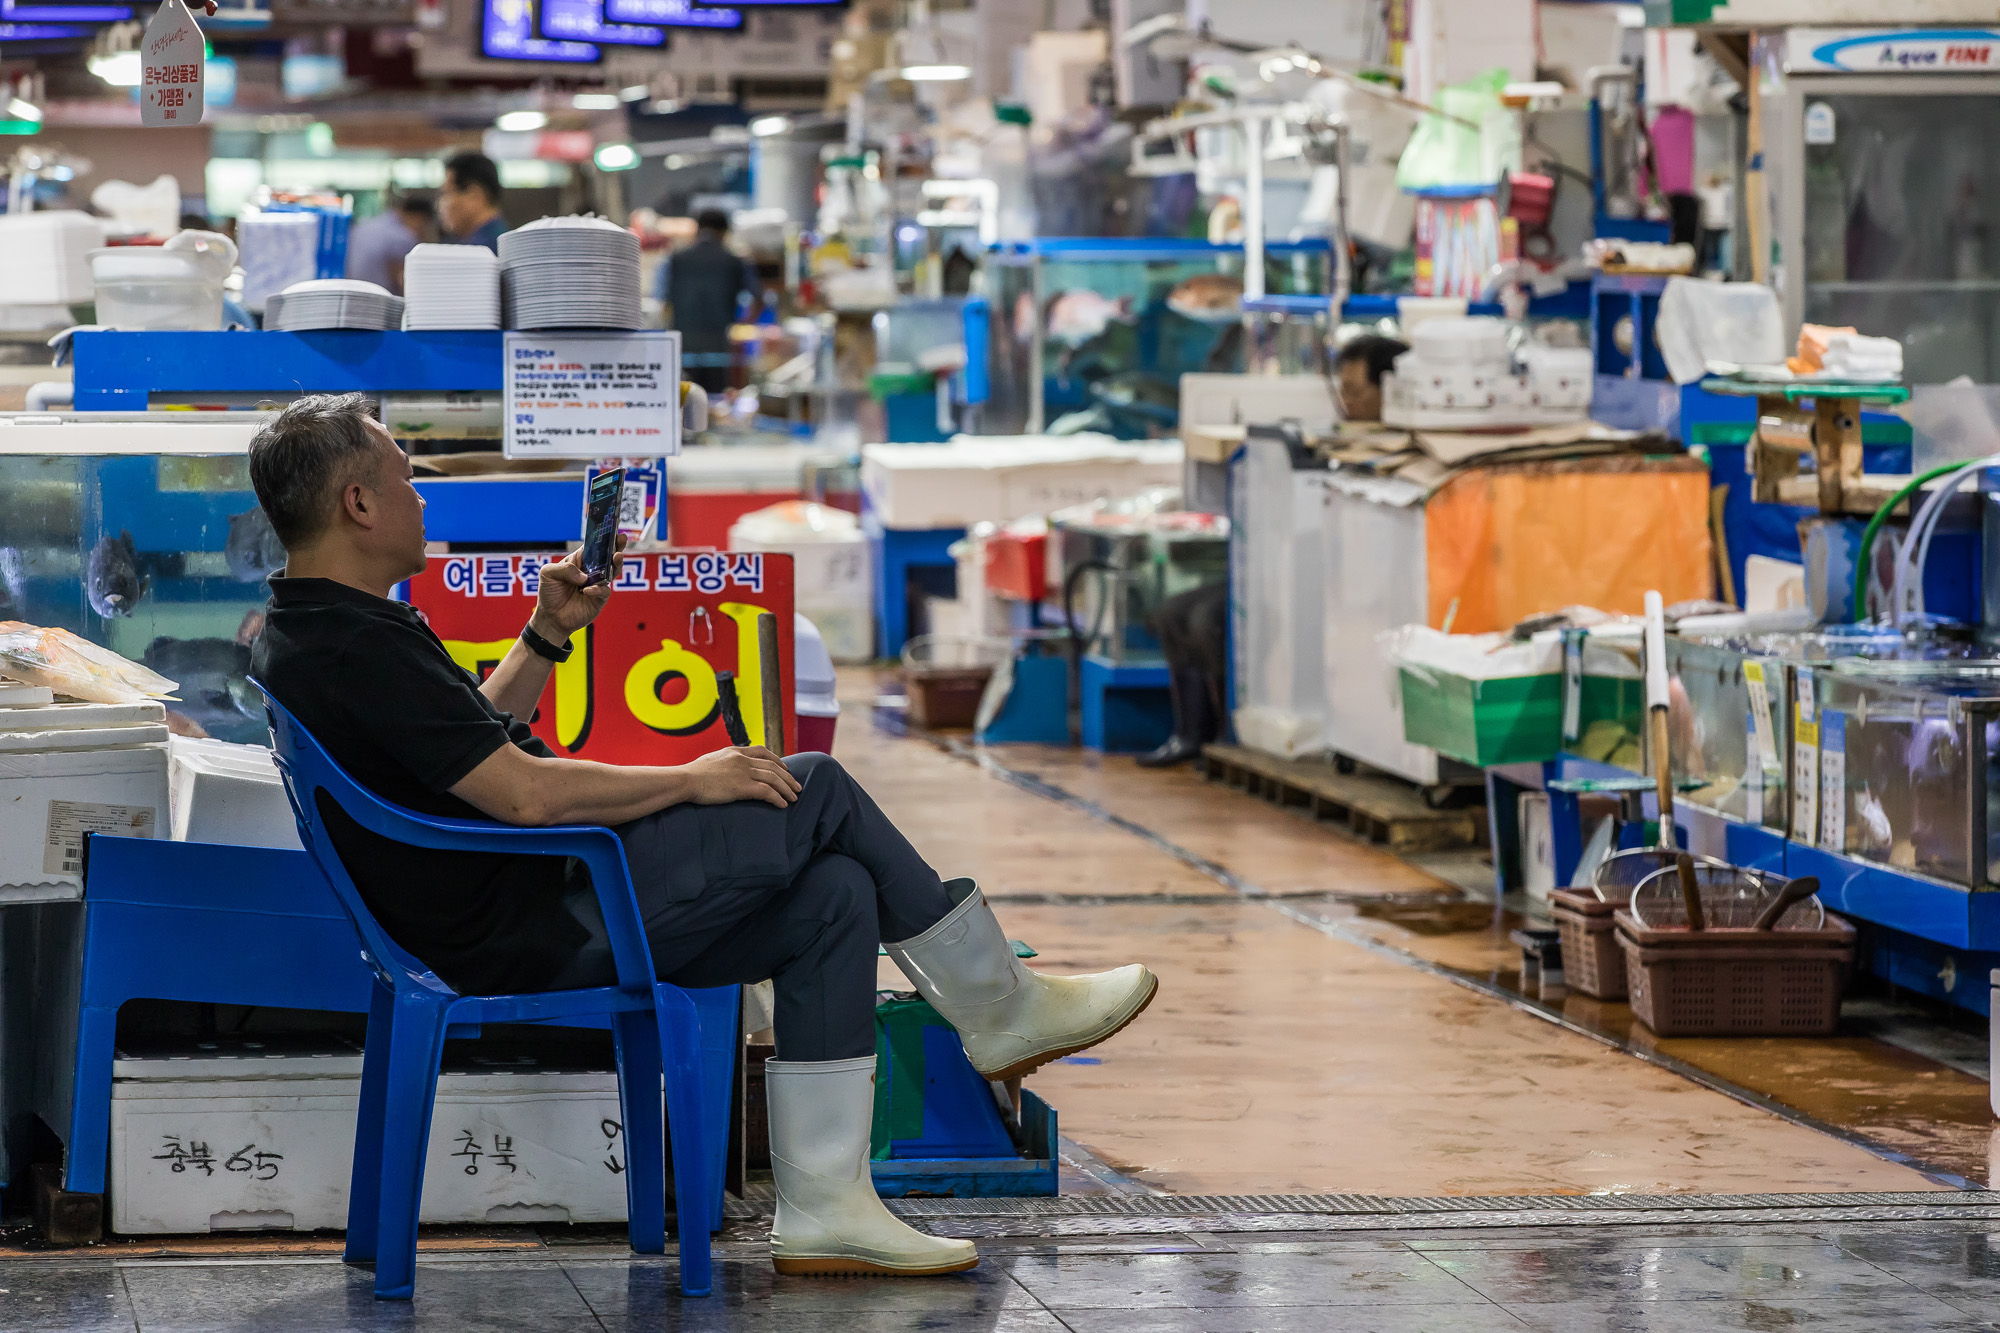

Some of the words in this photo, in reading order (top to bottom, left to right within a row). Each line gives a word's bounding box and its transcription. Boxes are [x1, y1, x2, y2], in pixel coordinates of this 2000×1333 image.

[1944, 45, 1991, 64] FINE
[145, 64, 198, 86] 온누리상품권
[157, 88, 184, 107] 가맹점
[654, 552, 764, 594] 보양식
[151, 1135, 217, 1176] 충북
[450, 1129, 517, 1176] 충북
